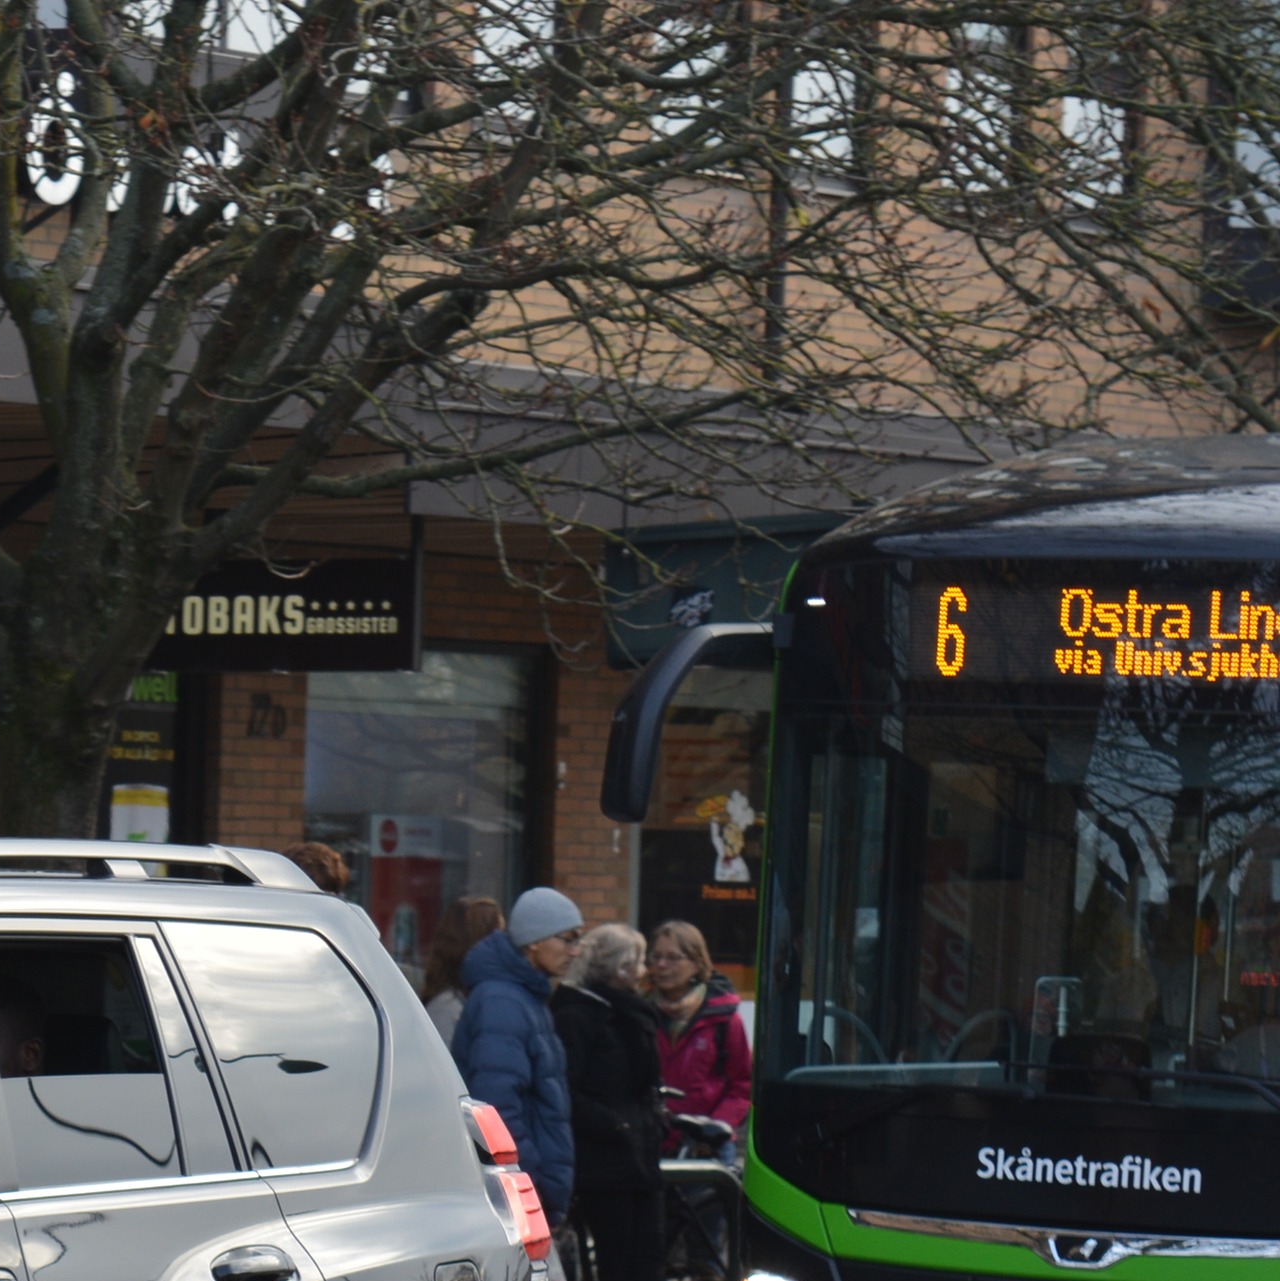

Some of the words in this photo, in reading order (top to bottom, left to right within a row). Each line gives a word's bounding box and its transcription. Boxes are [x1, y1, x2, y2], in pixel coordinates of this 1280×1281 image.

[935, 586, 968, 677] 6
[1208, 589, 1280, 641] Lin
[1053, 640, 1102, 675] via
[976, 1147, 1203, 1194] Skånetrafiken
